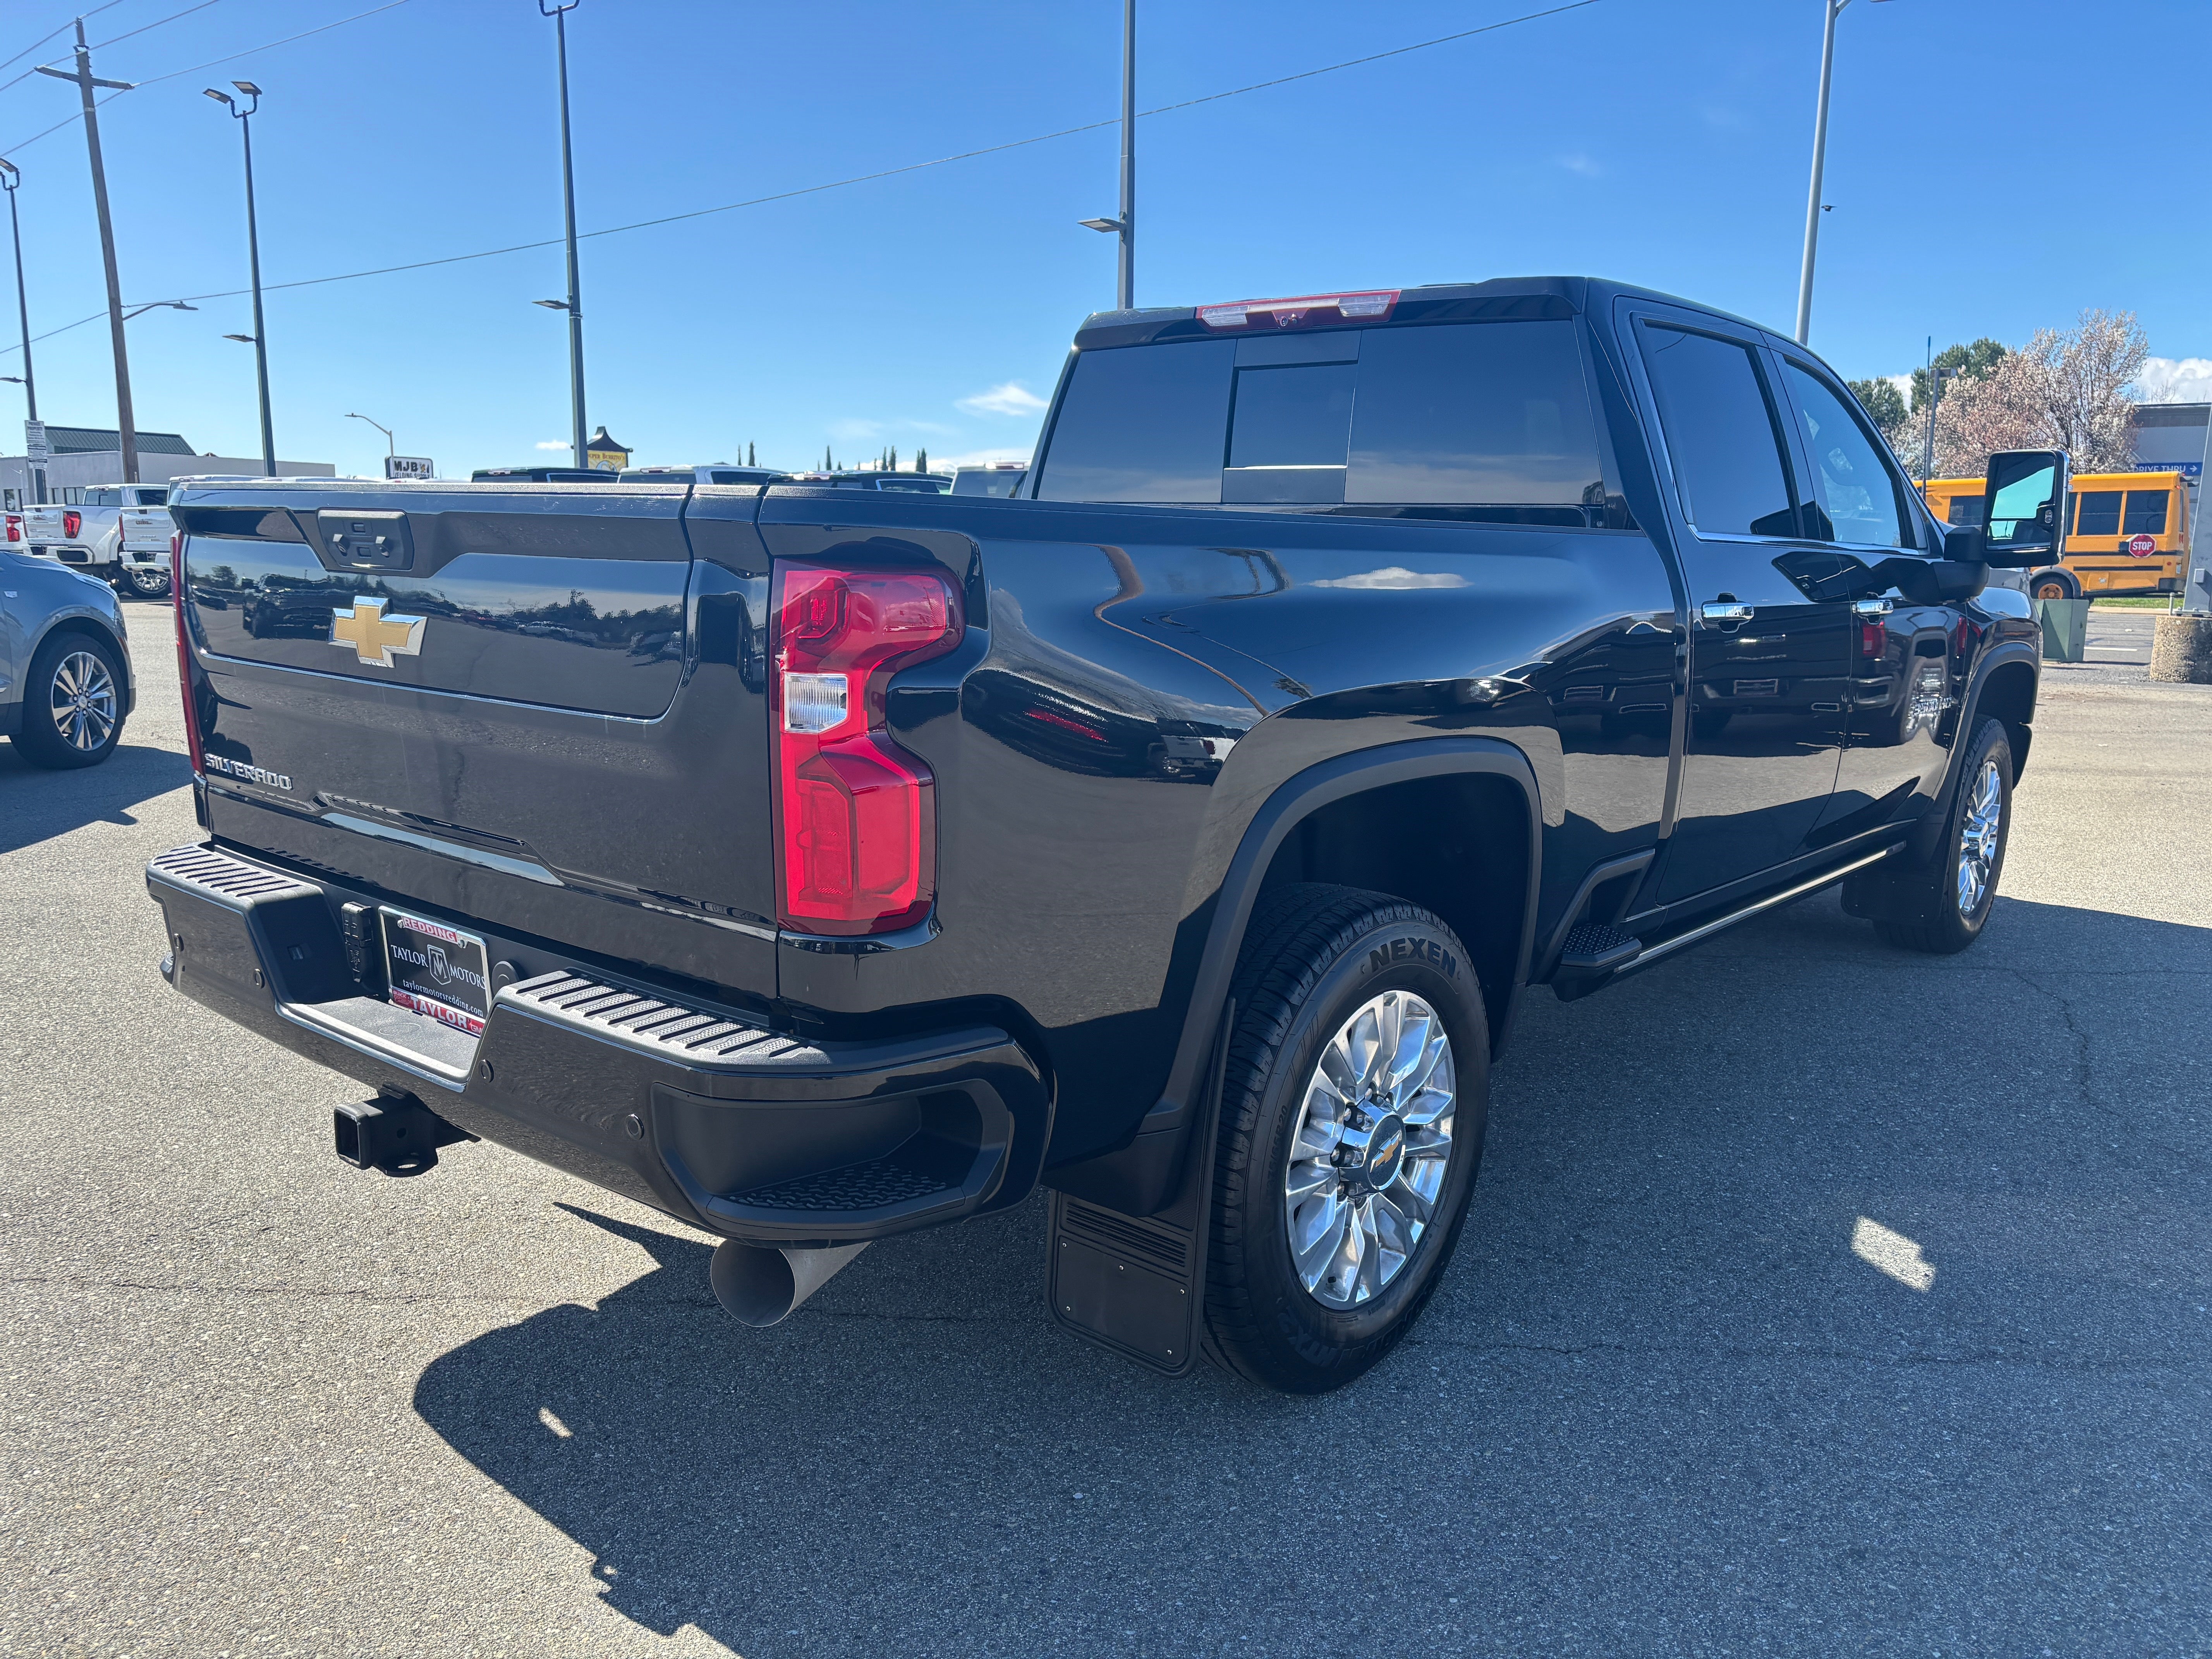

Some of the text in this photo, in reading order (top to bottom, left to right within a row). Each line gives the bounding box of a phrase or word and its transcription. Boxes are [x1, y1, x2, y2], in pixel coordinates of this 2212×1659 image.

[394, 460, 418, 472] MJB
[2132, 541, 2152, 551] STOP
[204, 753, 292, 790] SILVERADO
[404, 917, 455, 941] REDDING
[390, 945, 429, 967] TAYLOR
[1369, 937, 1456, 978] NEXEN
[450, 964, 486, 989] MOTORS
[403, 979, 483, 1017] taylormotorsredding.com
[410, 996, 467, 1029] TAYLOR
[471, 1024, 482, 1034] GM
